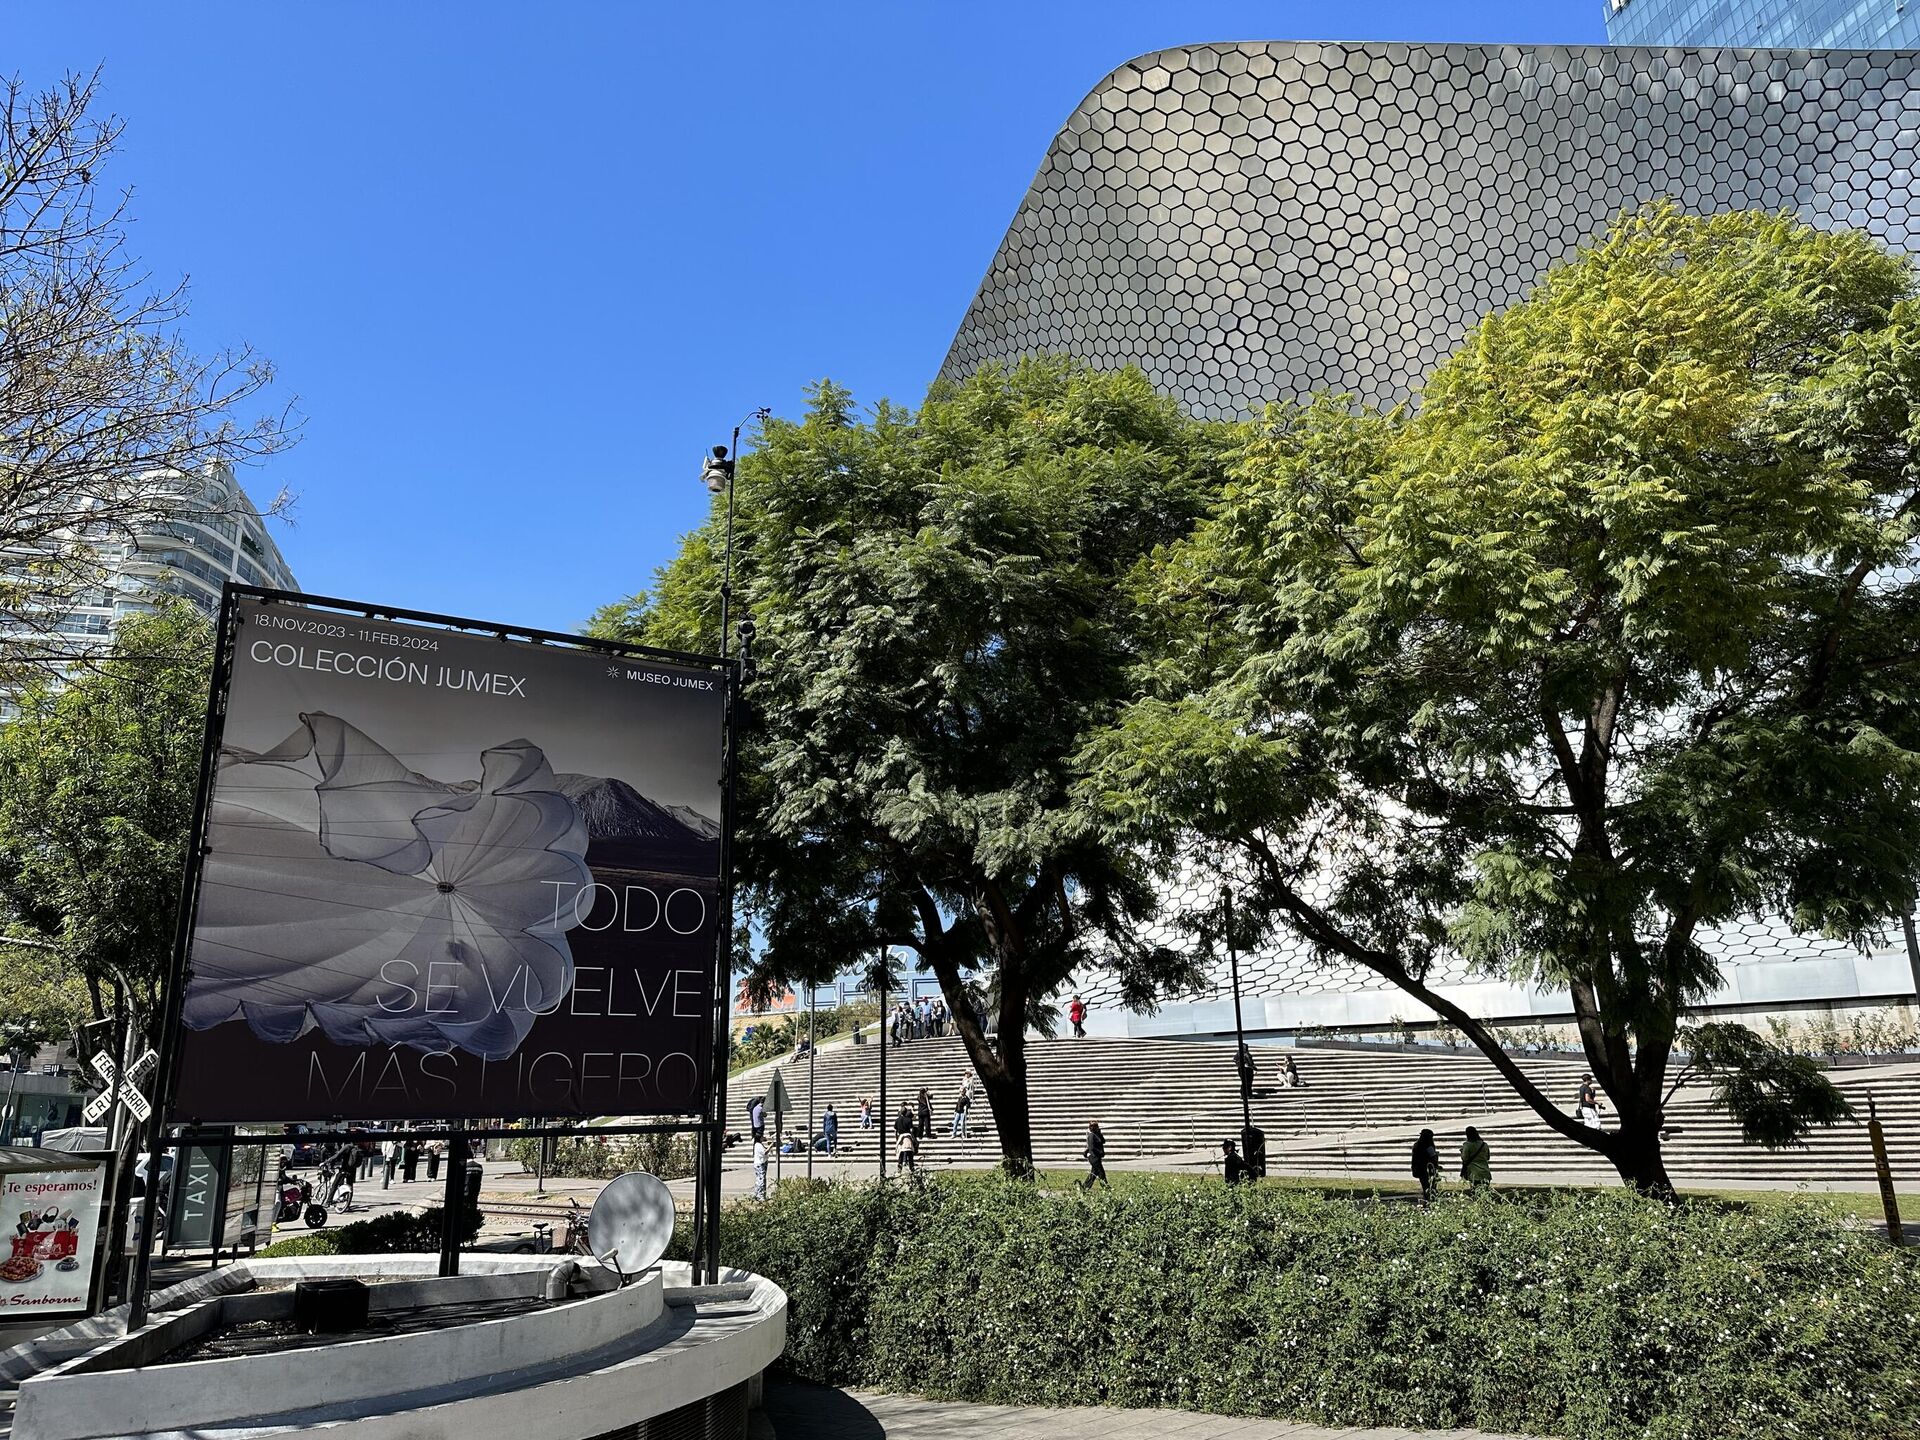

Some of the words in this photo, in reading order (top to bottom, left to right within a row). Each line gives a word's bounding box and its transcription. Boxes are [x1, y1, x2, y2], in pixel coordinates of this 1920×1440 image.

[253, 613, 346, 638] 18.NOV.2023
[358, 630, 440, 652] 11.FEB.2024
[250, 639, 428, 685] COLECCIÓN
[436, 666, 527, 698] JUMEX
[626, 670, 671, 686] MUSEO
[672, 677, 714, 692] JUMEX
[541, 880, 706, 935] TODO
[375, 959, 462, 1014] SE
[481, 963, 704, 1018] VUELVE
[306, 1041, 459, 1104] MÁS
[3, 1182, 21, 1196] ¡Te
[25, 1179, 98, 1195] esperamos!
[183, 1163, 210, 1221] TAXI
[9, 1294, 81, 1306] Sanborns
